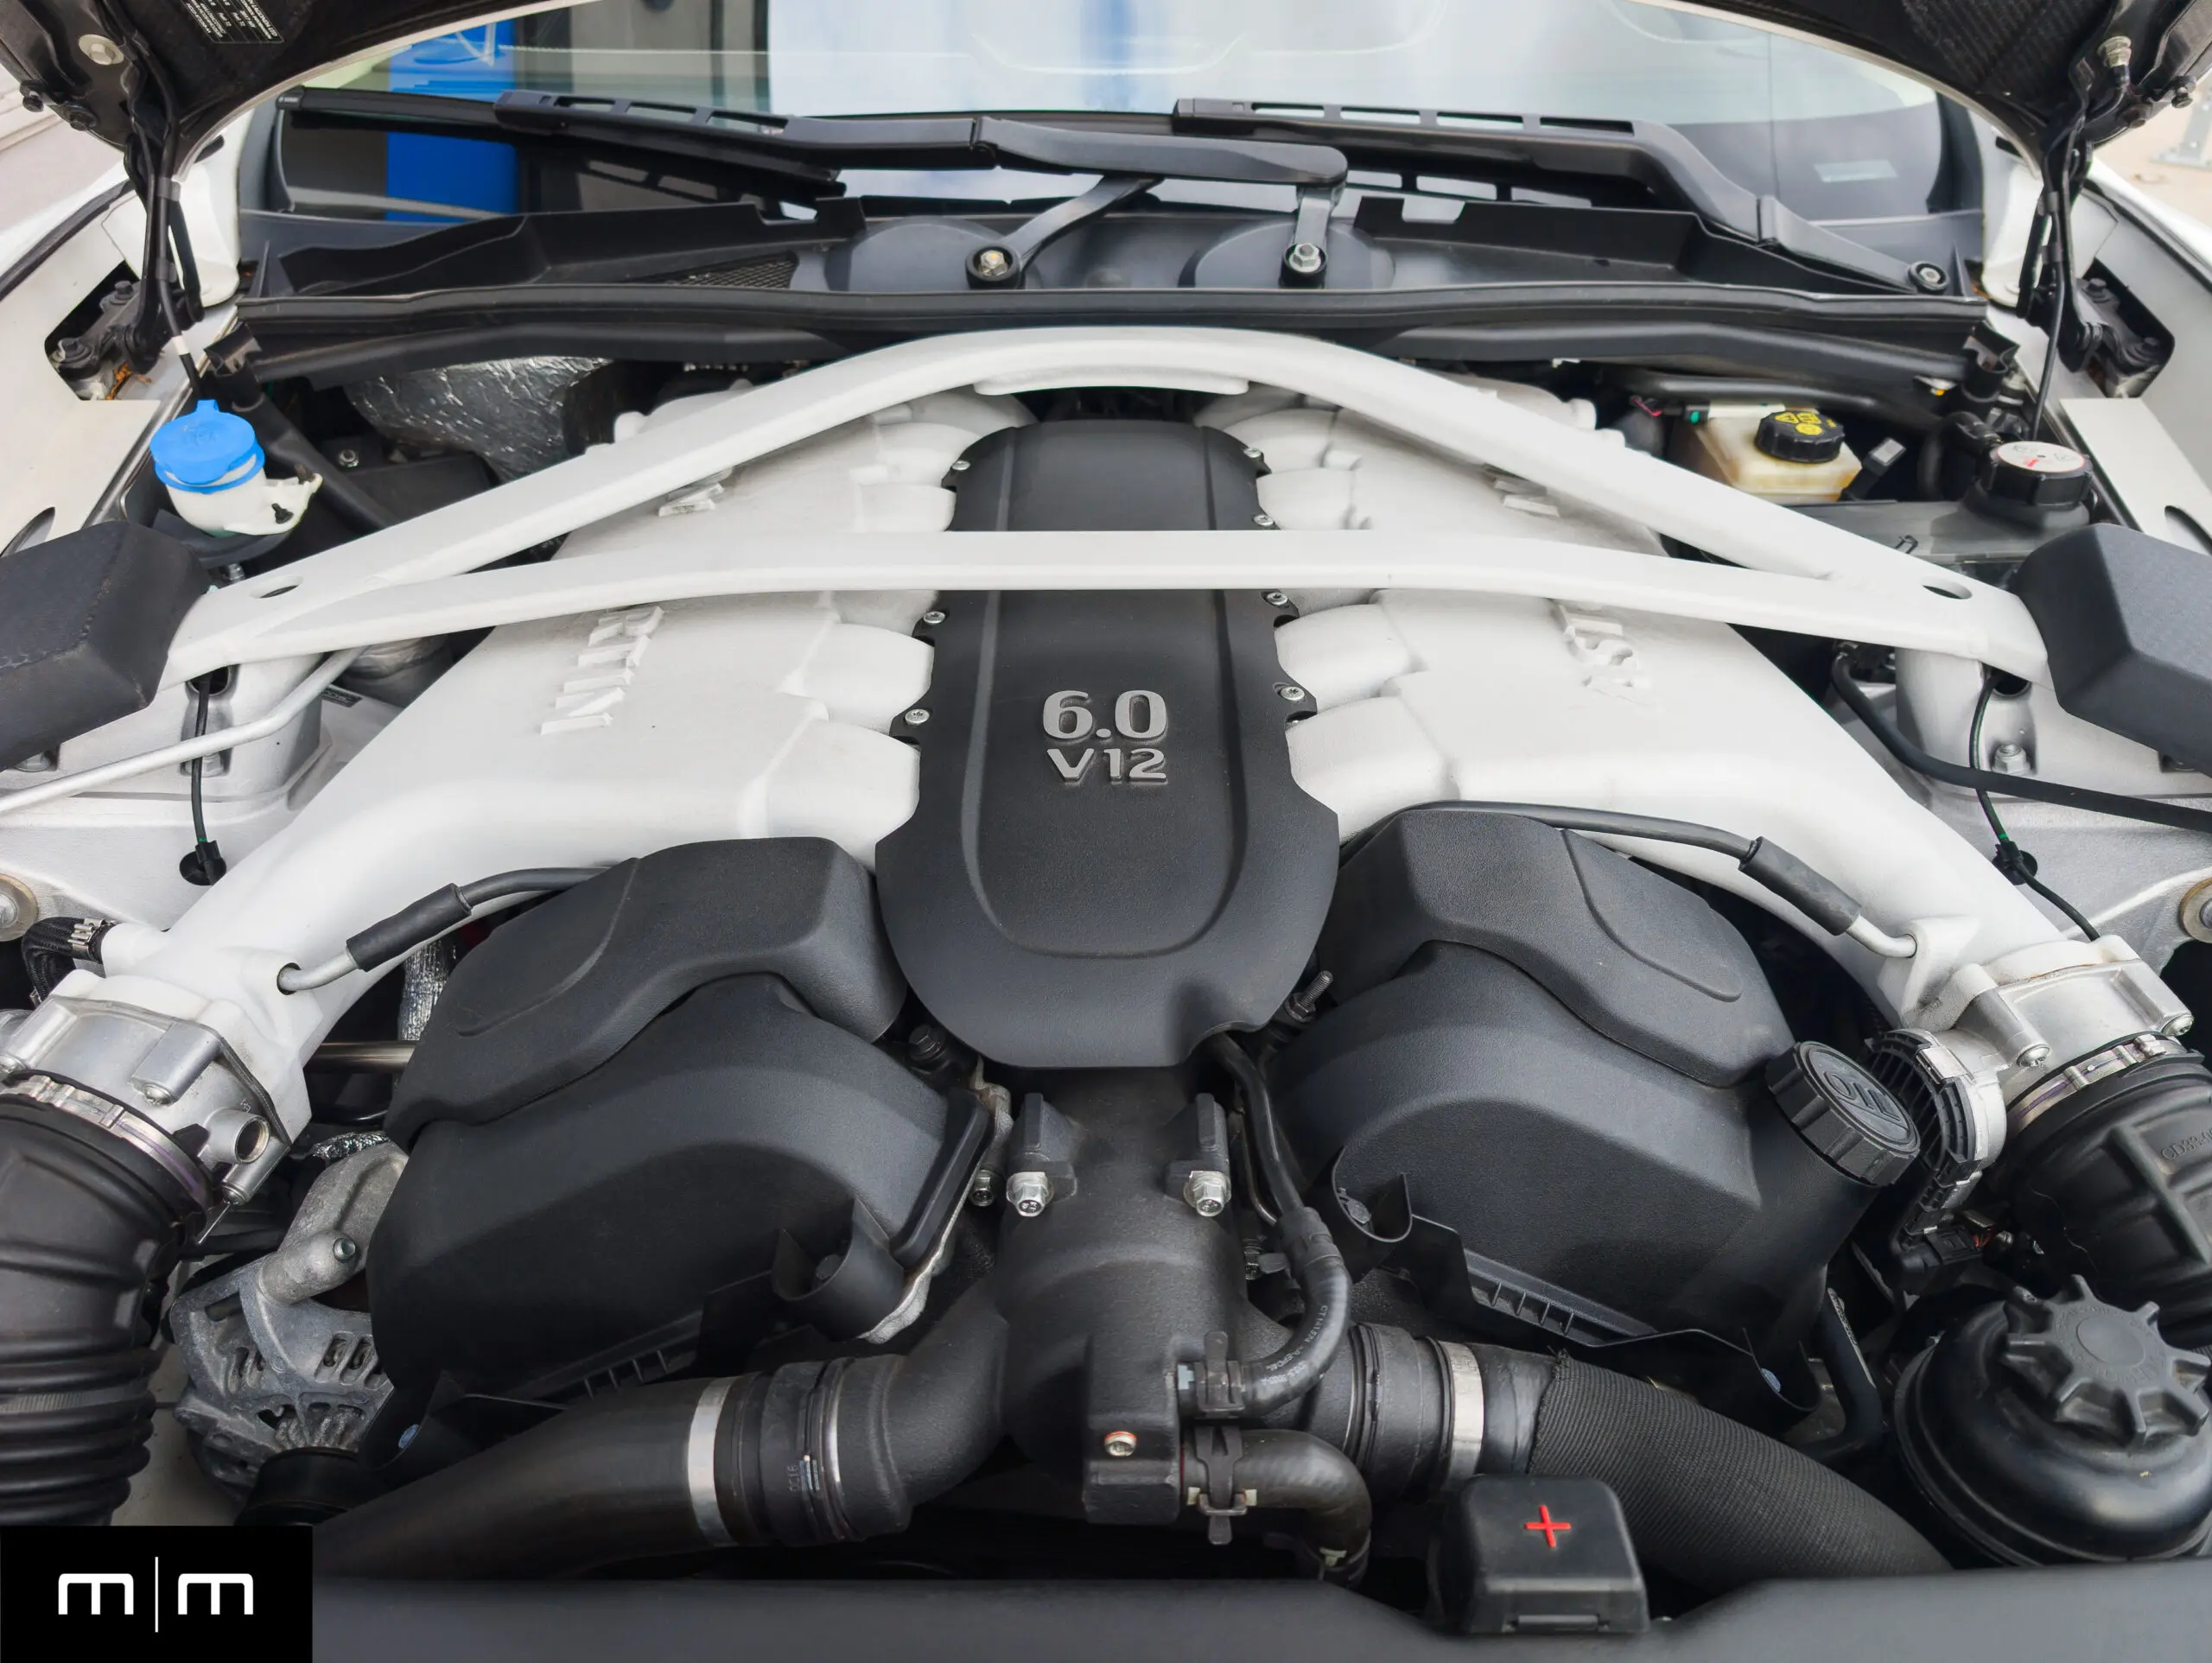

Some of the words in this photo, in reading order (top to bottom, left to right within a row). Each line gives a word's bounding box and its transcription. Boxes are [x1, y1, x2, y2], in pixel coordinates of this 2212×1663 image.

[1042, 689, 1167, 739] 6.0
[1046, 747, 1168, 781] V12
[1822, 1071, 1903, 1123] OIL
